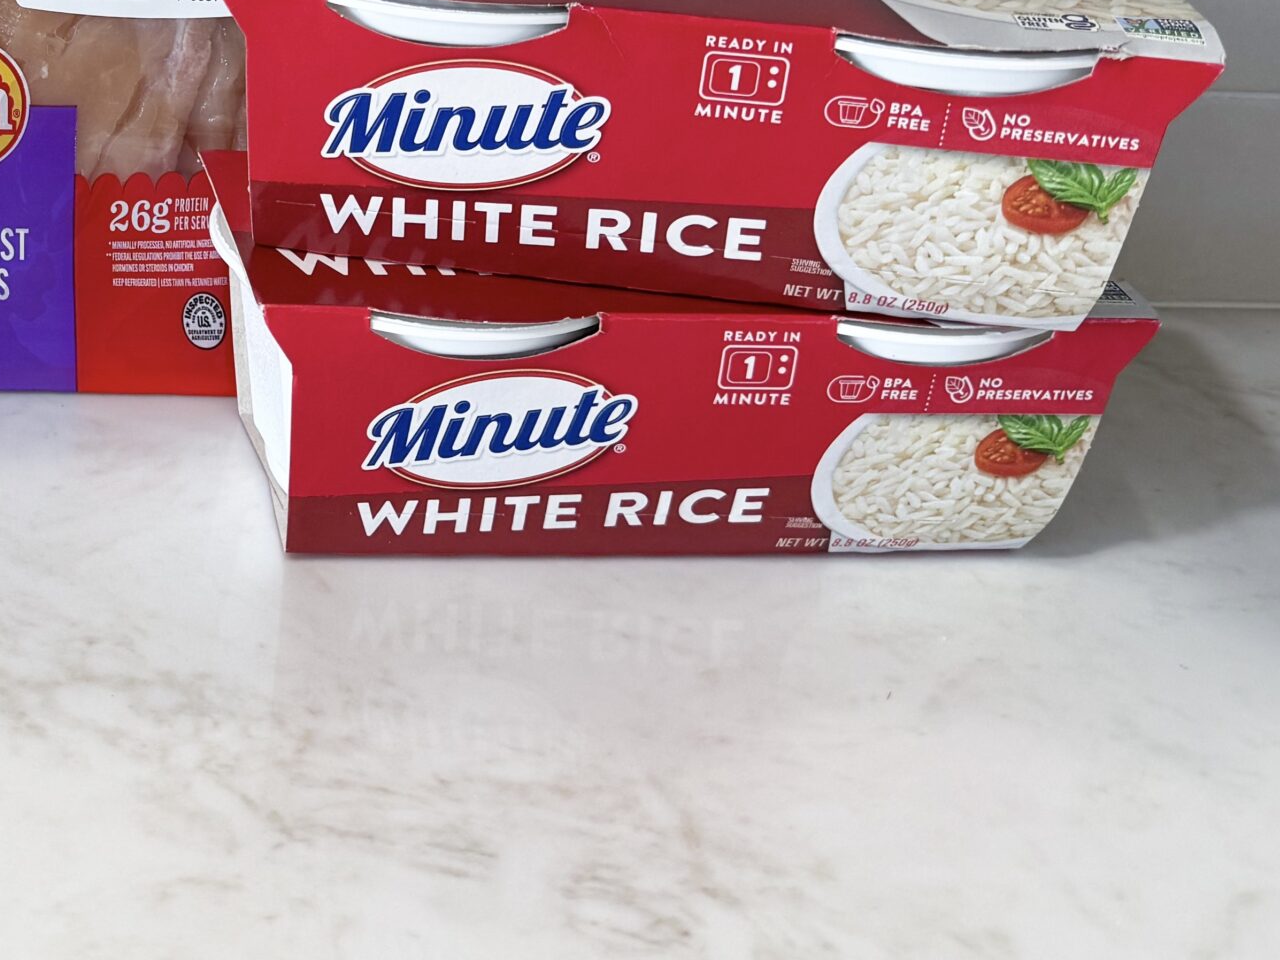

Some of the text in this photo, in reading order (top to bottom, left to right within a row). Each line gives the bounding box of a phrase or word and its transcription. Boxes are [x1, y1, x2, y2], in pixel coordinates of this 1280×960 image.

[705, 35, 793, 54] READY IN
[728, 64, 742, 91] 1
[694, 103, 783, 124] MINUTE
[889, 102, 923, 117] BPA
[323, 86, 609, 157] Minute
[887, 117, 930, 132] FREE
[1003, 113, 1031, 127] NO
[1000, 127, 1139, 151] PRESERVATIVES
[174, 197, 209, 212] PROTEIN
[109, 198, 173, 234] 26g
[174, 216, 189, 231] PER
[320, 193, 767, 262] WHITE RICE
[184, 295, 223, 320] INSPECTED
[783, 283, 949, 315] NET WT 8.8 OZ (250g)
[723, 330, 801, 343] READY IN
[743, 355, 756, 380] 1
[883, 377, 913, 388] BPA
[979, 377, 1003, 388] NO
[712, 392, 791, 406] MINUTE
[881, 389, 919, 400] FREE
[976, 389, 1094, 401] PRESERVATIVES
[364, 387, 635, 470] Minute
[357, 487, 771, 538] WHITE RICE
[775, 537, 920, 549] NET WT 8.8 OZ (250g)
